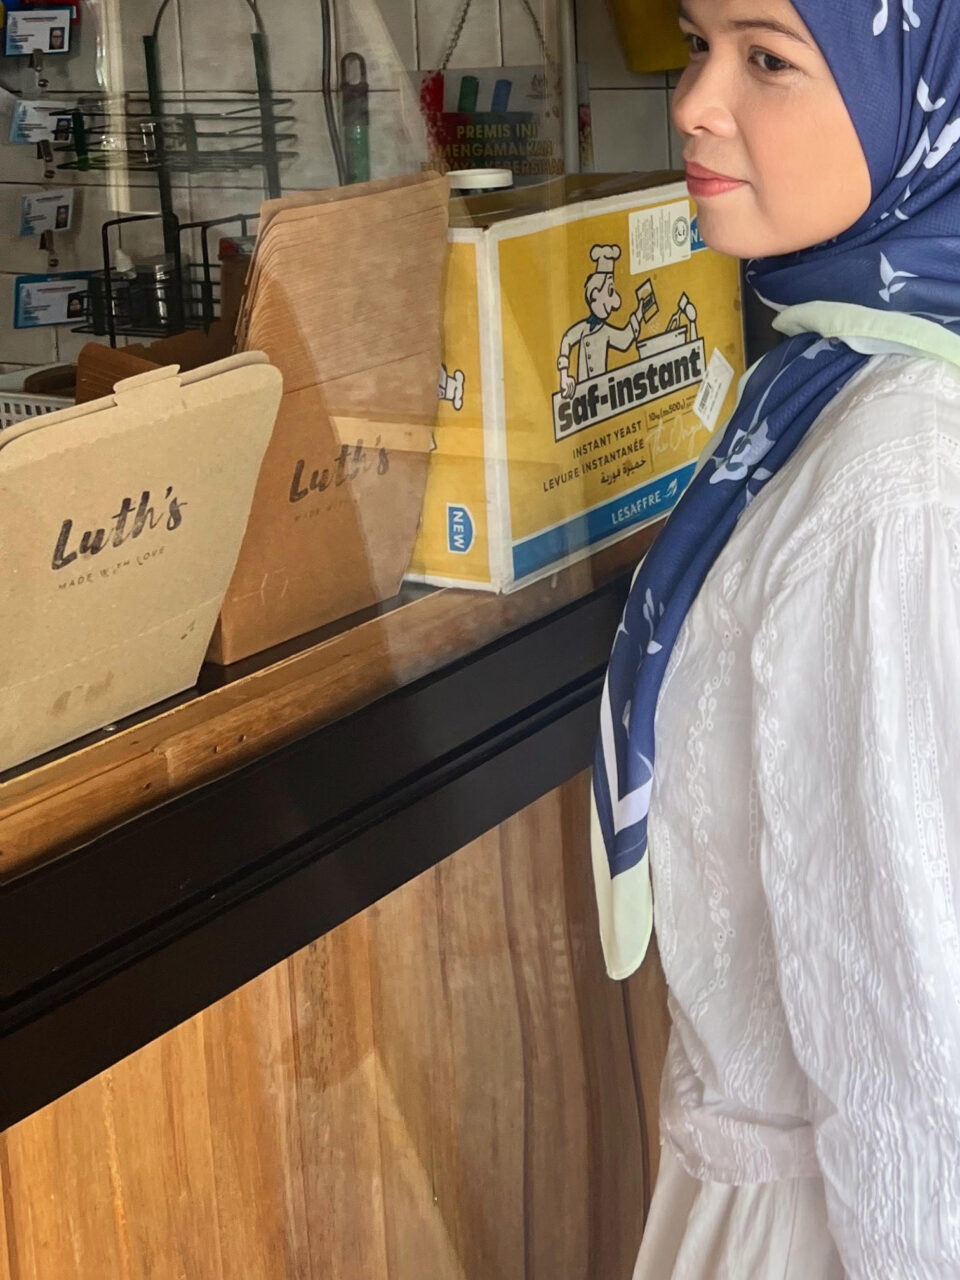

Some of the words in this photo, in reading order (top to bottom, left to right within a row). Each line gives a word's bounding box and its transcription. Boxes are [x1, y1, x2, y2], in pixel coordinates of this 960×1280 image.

[456, 123, 511, 139] PREMIS
[516, 122, 539, 138] INI
[558, 348, 702, 433] saf-instant
[573, 434, 612, 459] INSTANT
[613, 420, 643, 441] YEAST
[289, 434, 390, 504] Luth's
[543, 467, 580, 492] LEVURE
[581, 438, 645, 473] INSTANTANÉE
[51, 486, 189, 571] Luth's
[452, 510, 465, 549] NEW
[611, 491, 662, 525] LESAFFRE
[57, 572, 94, 591] MADE
[135, 545, 166, 566] LOVE
